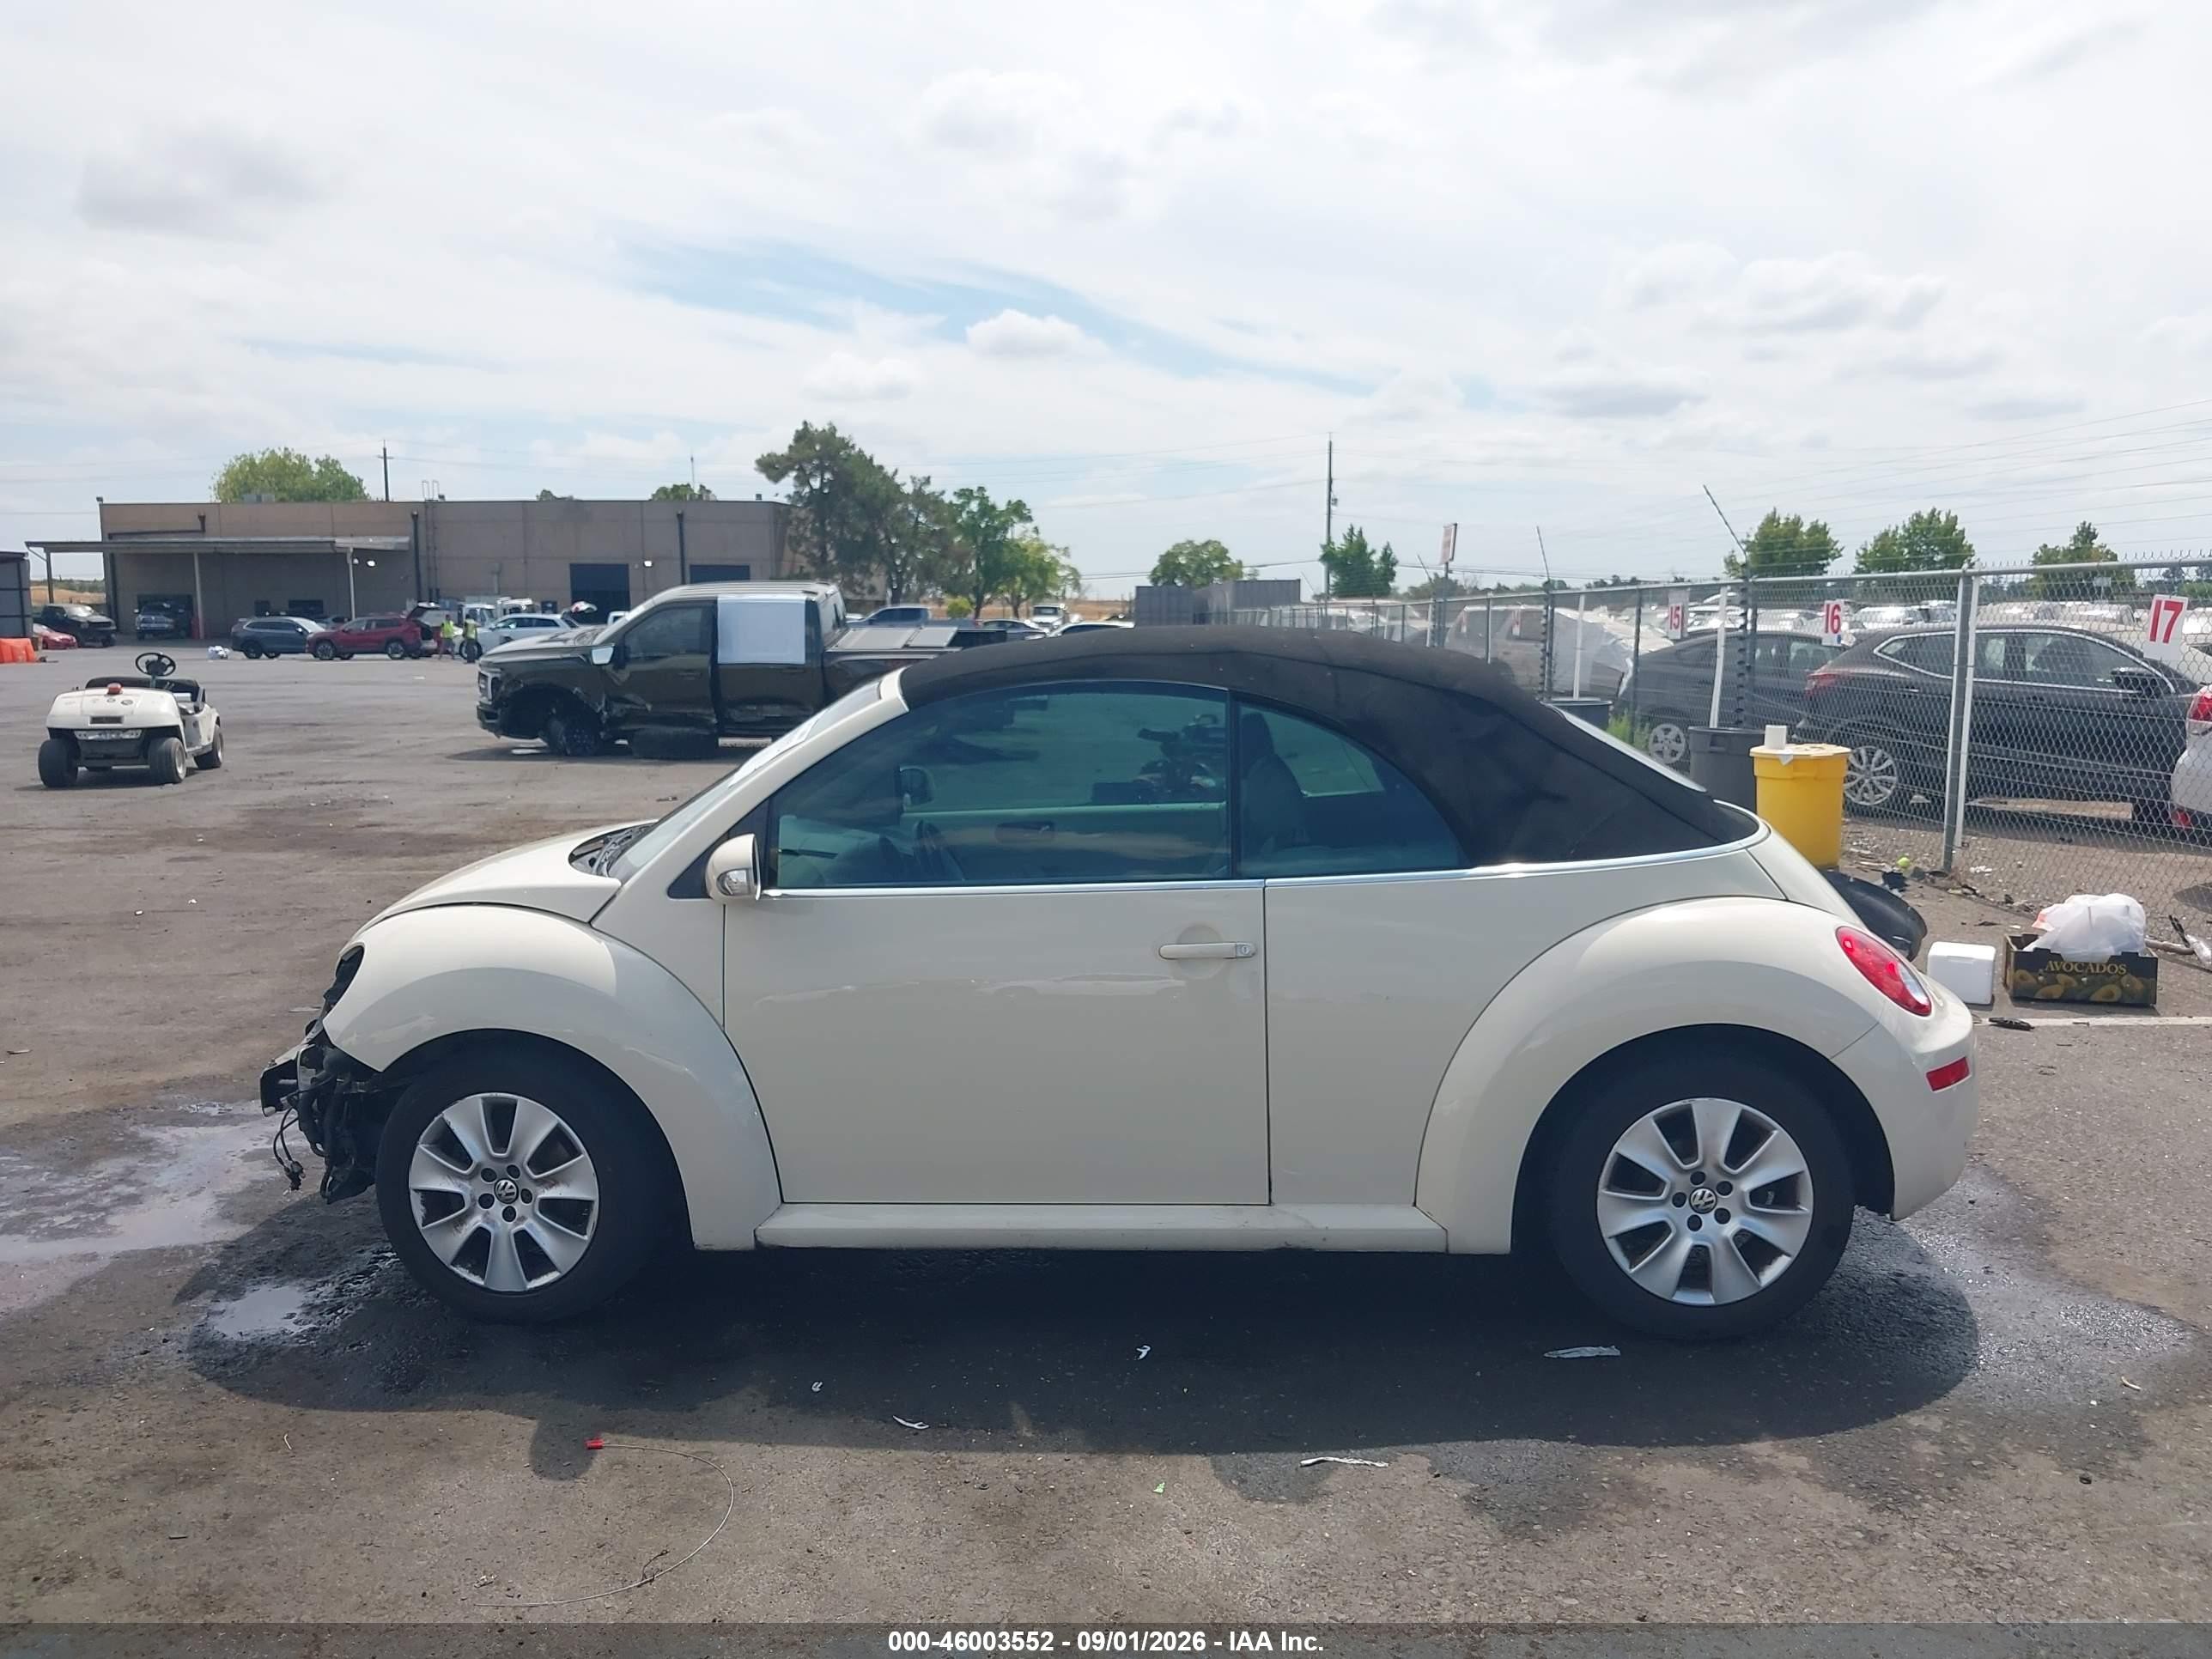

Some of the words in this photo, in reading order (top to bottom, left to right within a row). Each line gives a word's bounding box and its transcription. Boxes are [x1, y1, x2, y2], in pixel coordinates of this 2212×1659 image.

[1669, 605, 1680, 630] 15
[1825, 604, 1842, 634] 16
[2149, 599, 2185, 644] 17
[2045, 961, 2127, 975] AVOCADOS
